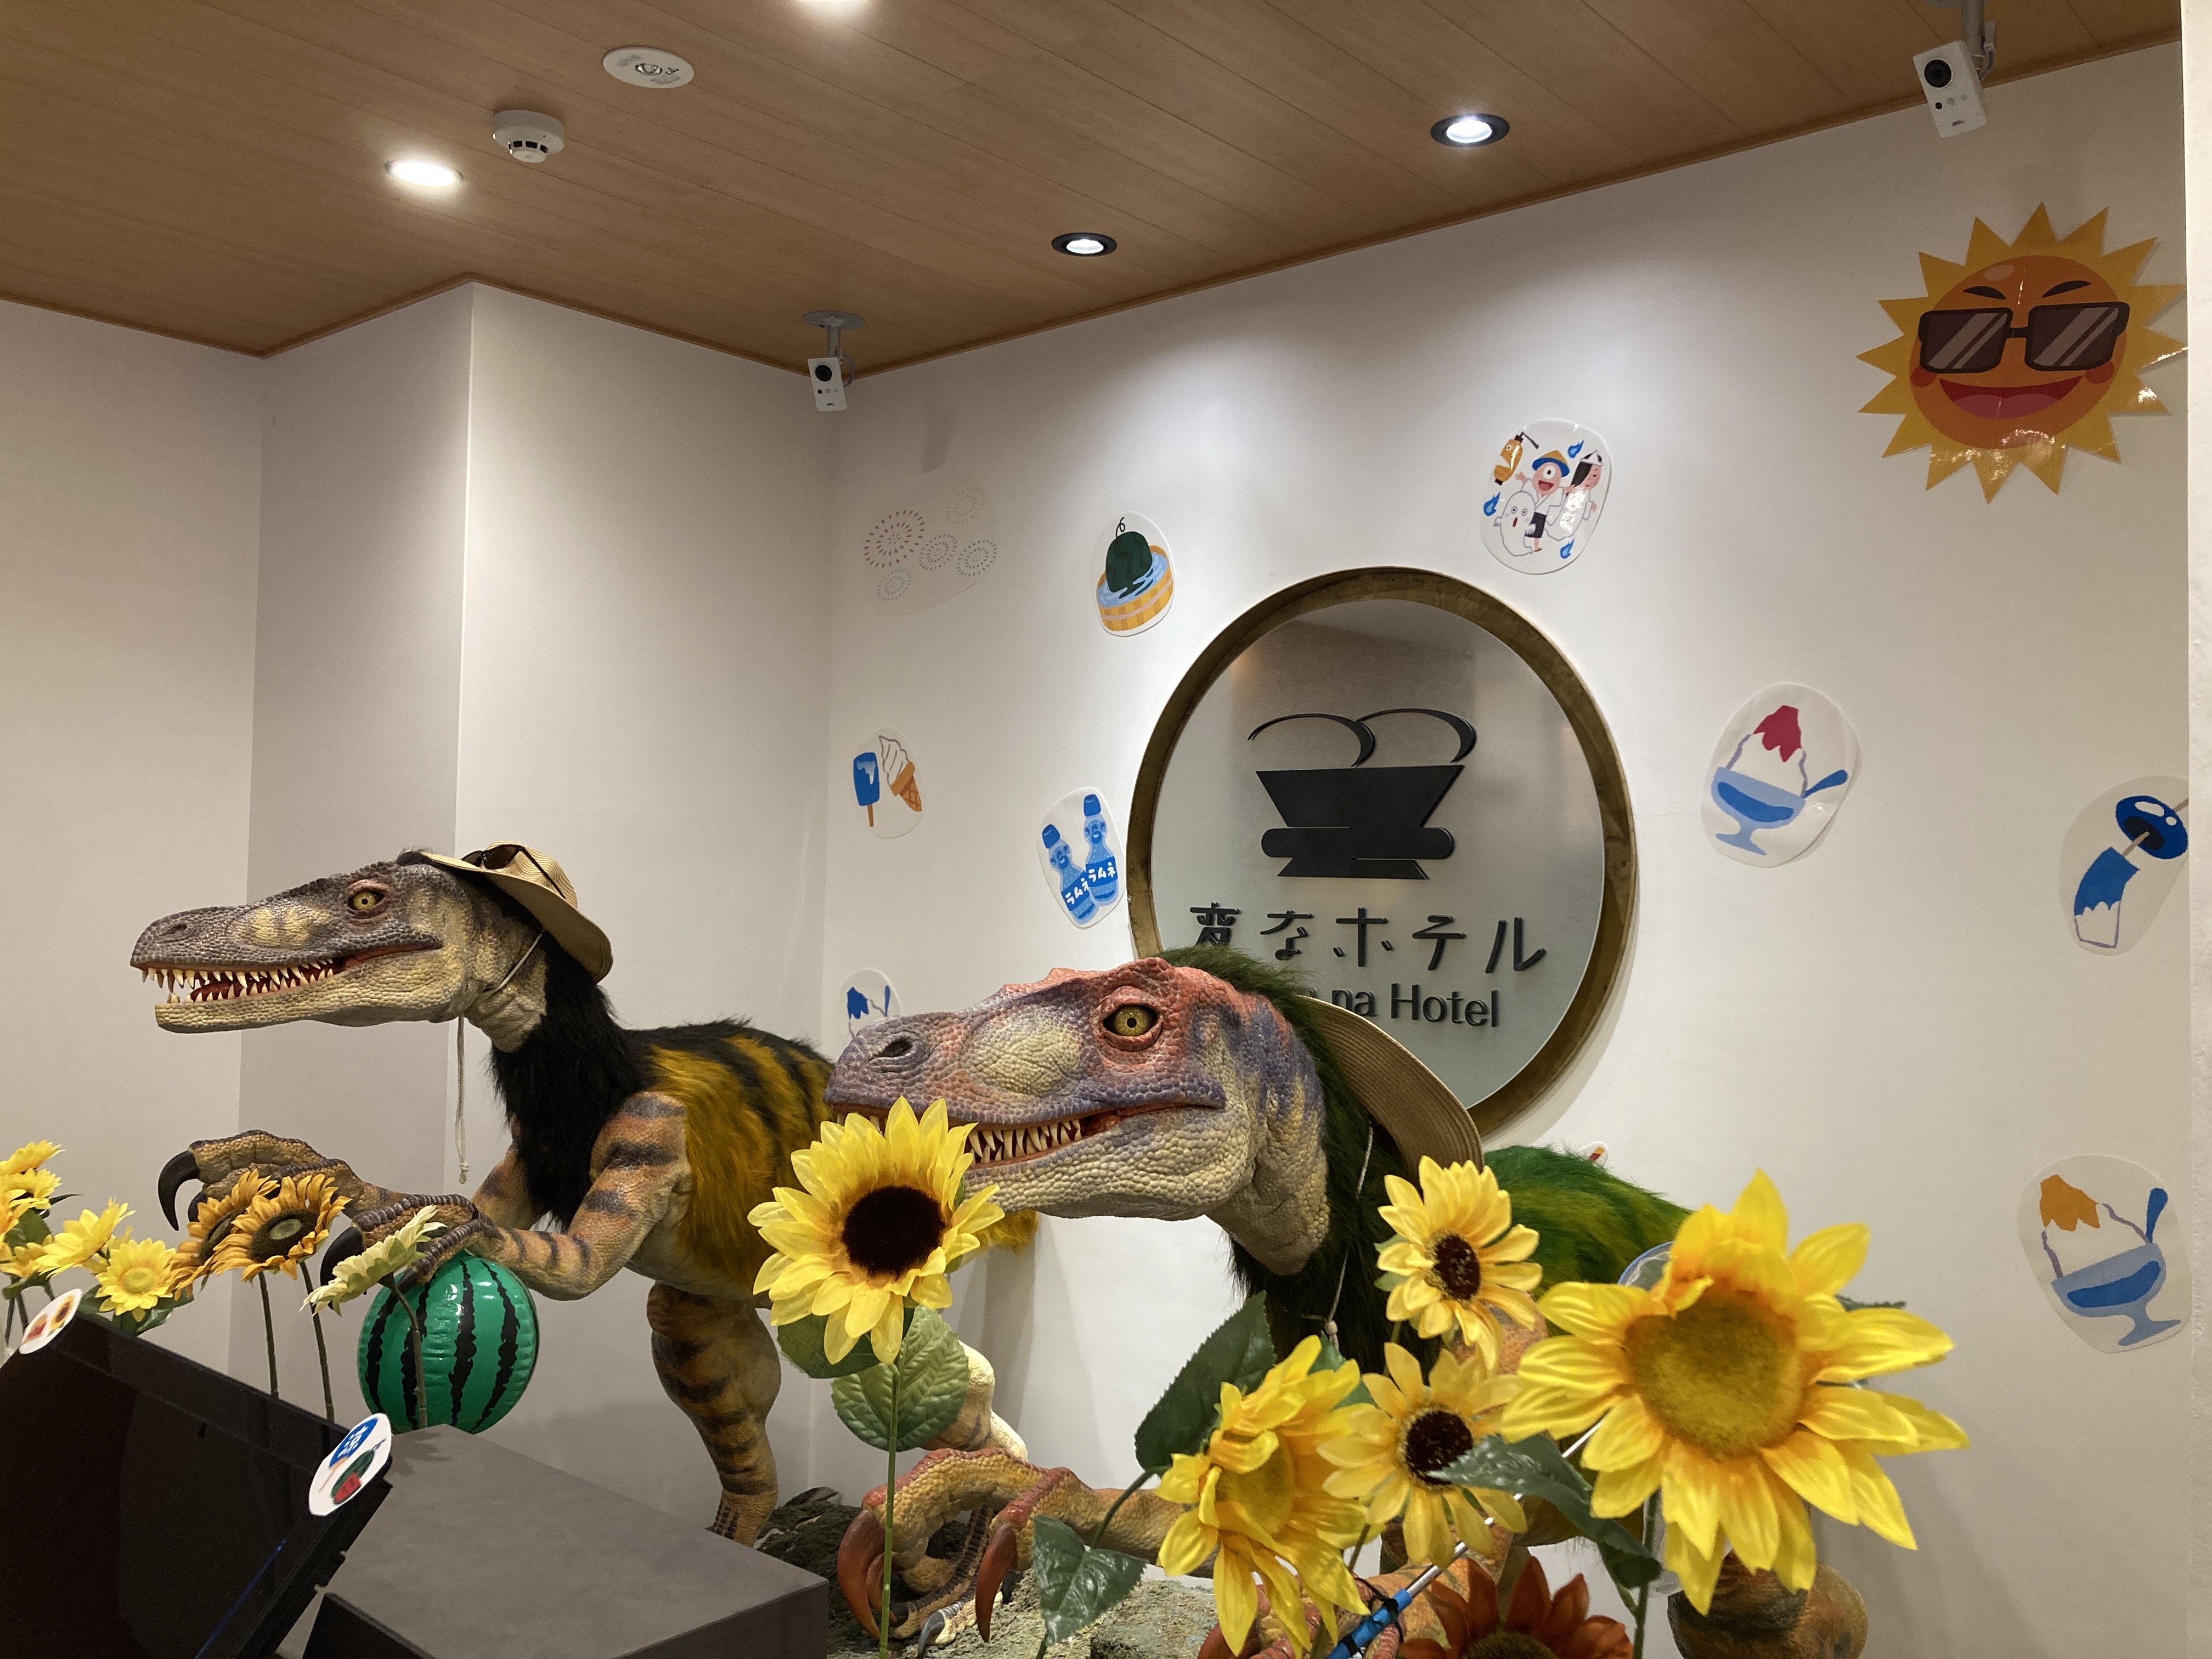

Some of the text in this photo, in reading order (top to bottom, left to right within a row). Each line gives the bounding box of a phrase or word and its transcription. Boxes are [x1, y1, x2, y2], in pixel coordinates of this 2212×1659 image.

[1088, 861, 1116, 882] ラムネ
[1065, 877, 1090, 905] ラムネ
[1331, 983, 1499, 1027] na Hotel
